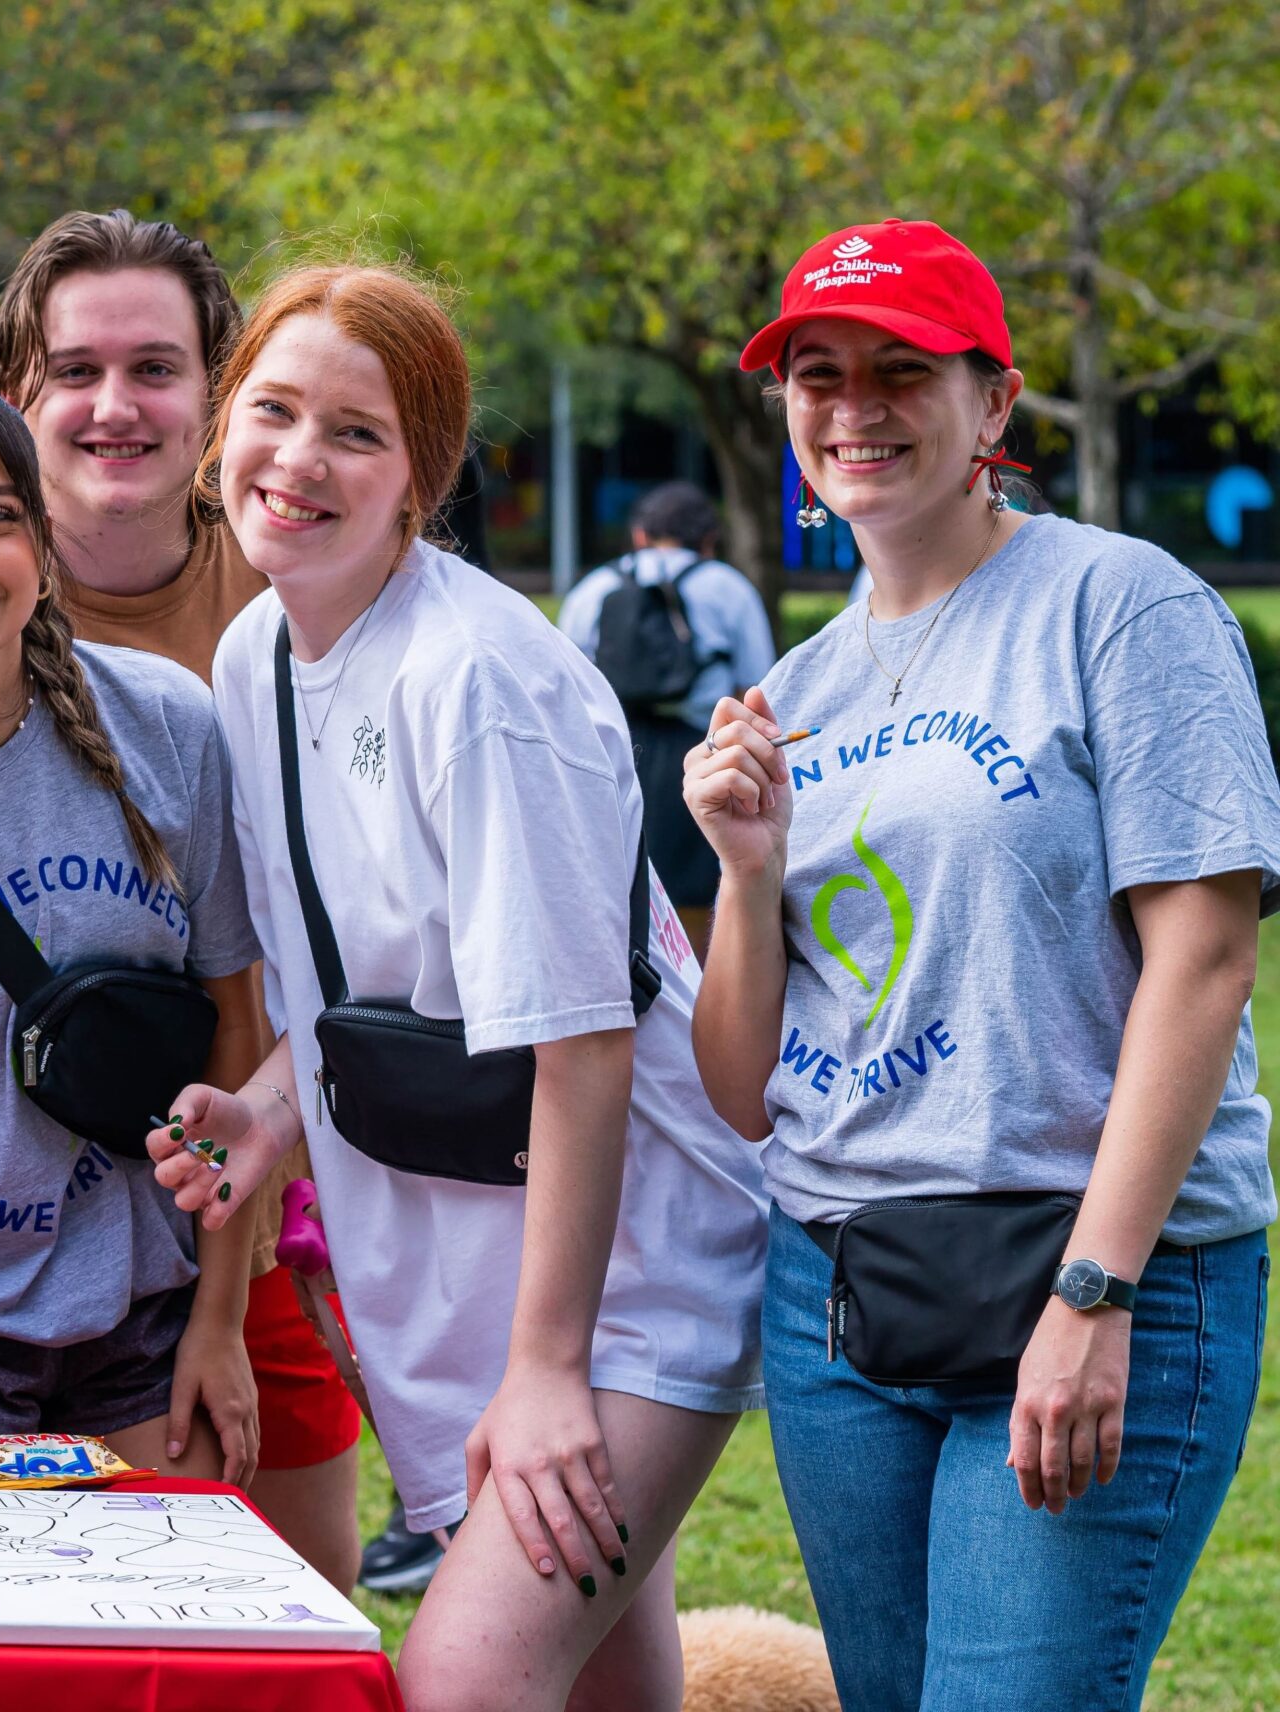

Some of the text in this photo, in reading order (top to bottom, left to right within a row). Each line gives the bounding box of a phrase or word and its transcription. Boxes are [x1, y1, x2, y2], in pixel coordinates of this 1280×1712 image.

[803, 259, 902, 286] Texas Children's
[813, 272, 872, 292] Hospital
[839, 723, 895, 770] WE
[903, 710, 1040, 802] CONNECT
[781, 1027, 842, 1094] WE
[90, 1600, 348, 1624] YOU
